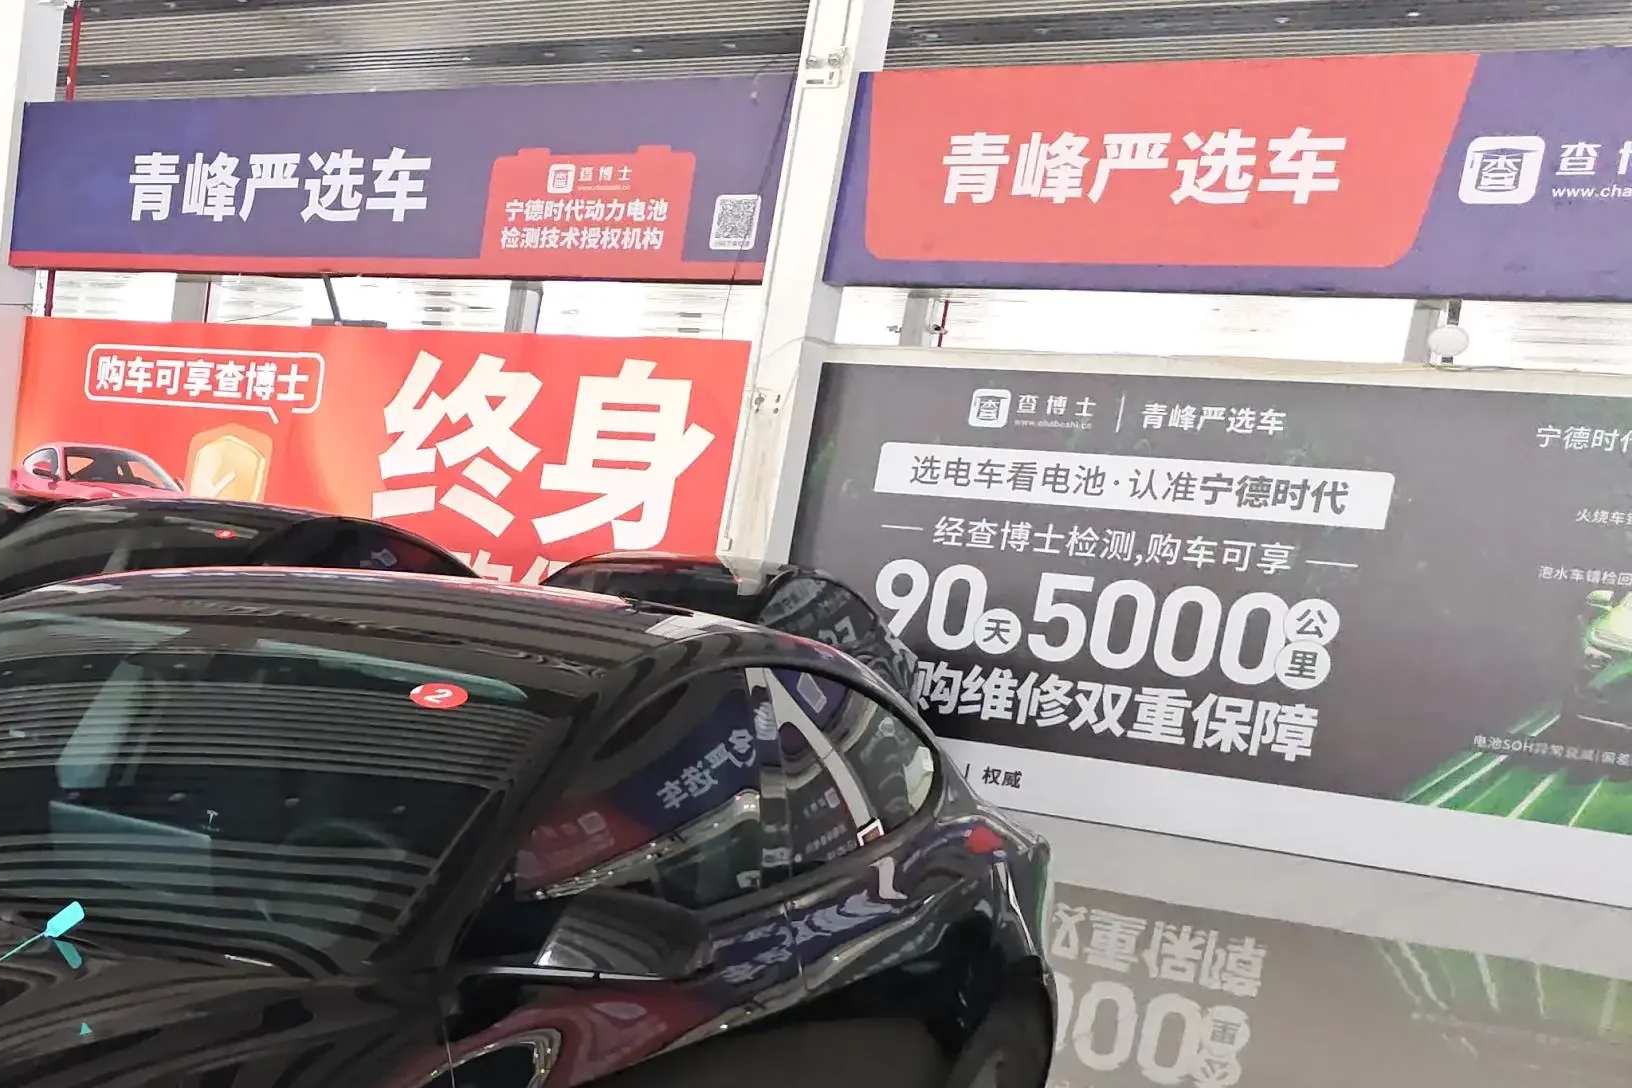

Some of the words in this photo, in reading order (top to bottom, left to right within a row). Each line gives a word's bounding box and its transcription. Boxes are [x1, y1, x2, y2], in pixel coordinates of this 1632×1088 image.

[943, 126, 1347, 205] 青峰严选车
[129, 147, 432, 222] 青峰严选车
[505, 198, 668, 223] 宁德时代动力电池
[500, 226, 665, 250] 检测技术授权机构
[96, 355, 309, 402] 购车可享查博士
[1016, 395, 1097, 416] 查博士
[1142, 402, 1287, 435] 青峰严选车
[372, 350, 715, 550] 终身
[981, 766, 1022, 789] 权威
